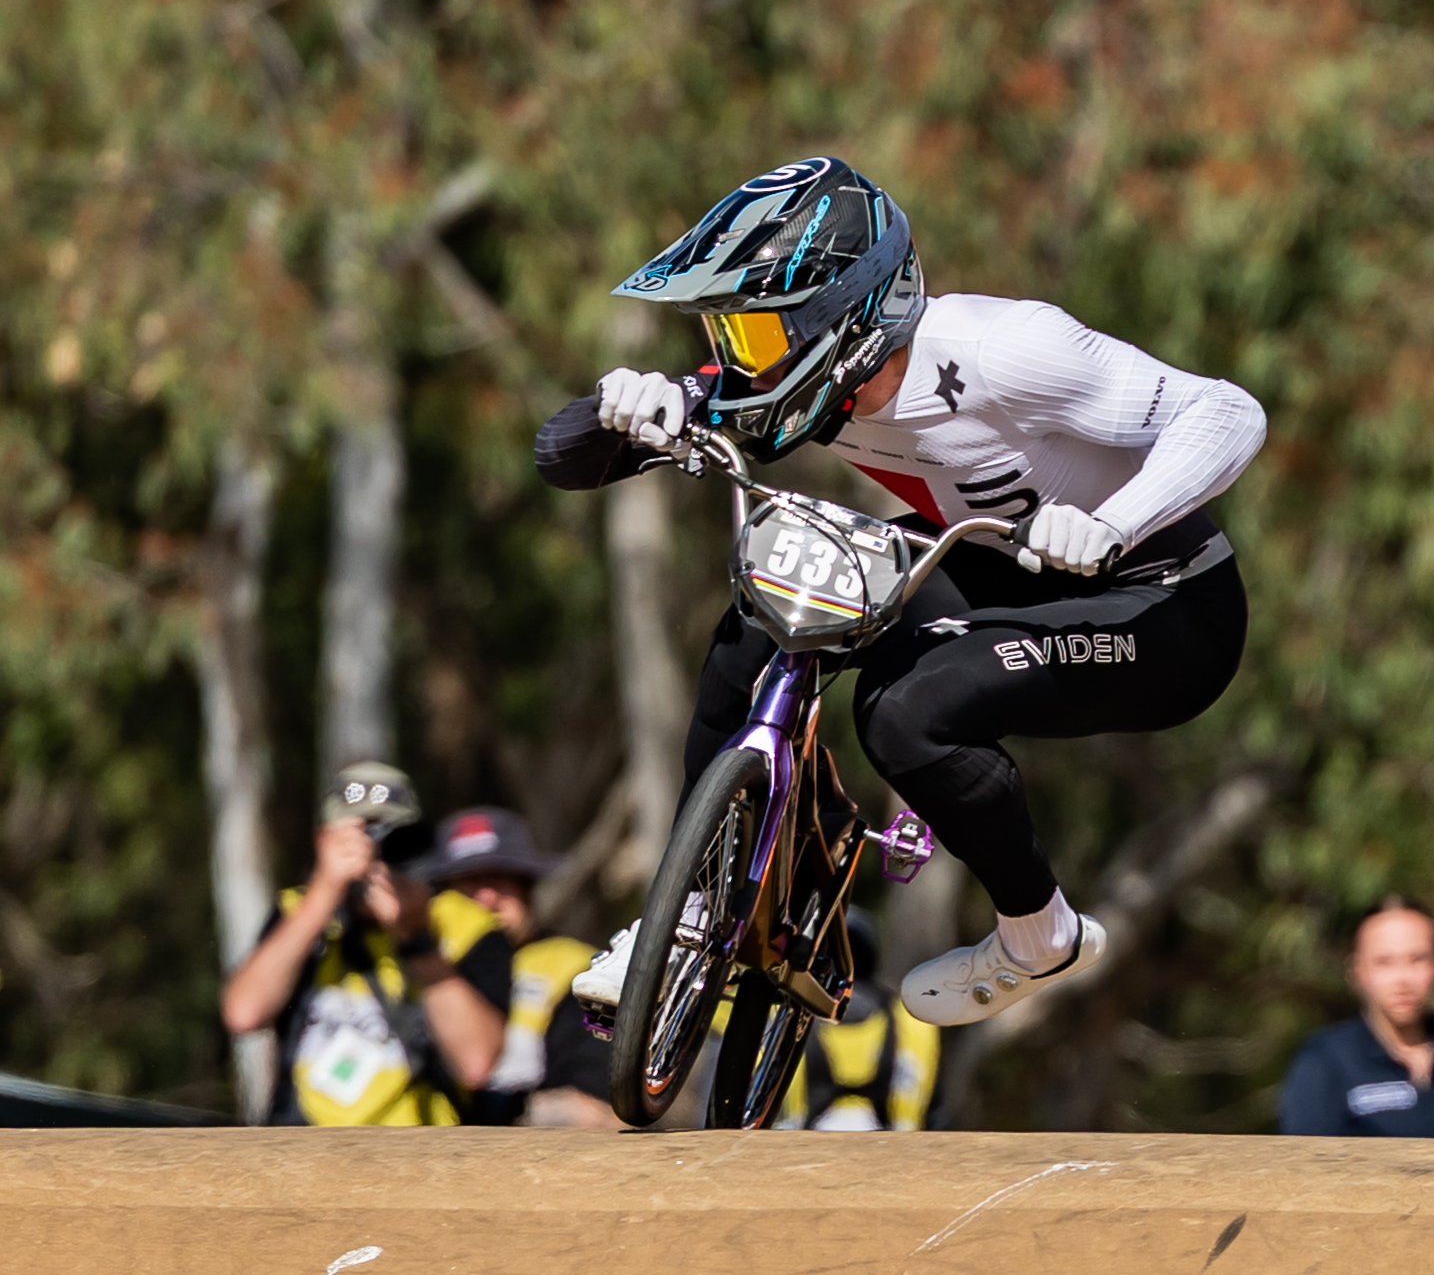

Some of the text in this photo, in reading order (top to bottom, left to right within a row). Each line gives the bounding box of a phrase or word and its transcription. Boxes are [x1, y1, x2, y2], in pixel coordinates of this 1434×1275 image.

[1141, 376, 1167, 429] VOLVO
[767, 528, 872, 600] 533
[993, 633, 1137, 671] EVIDEN
